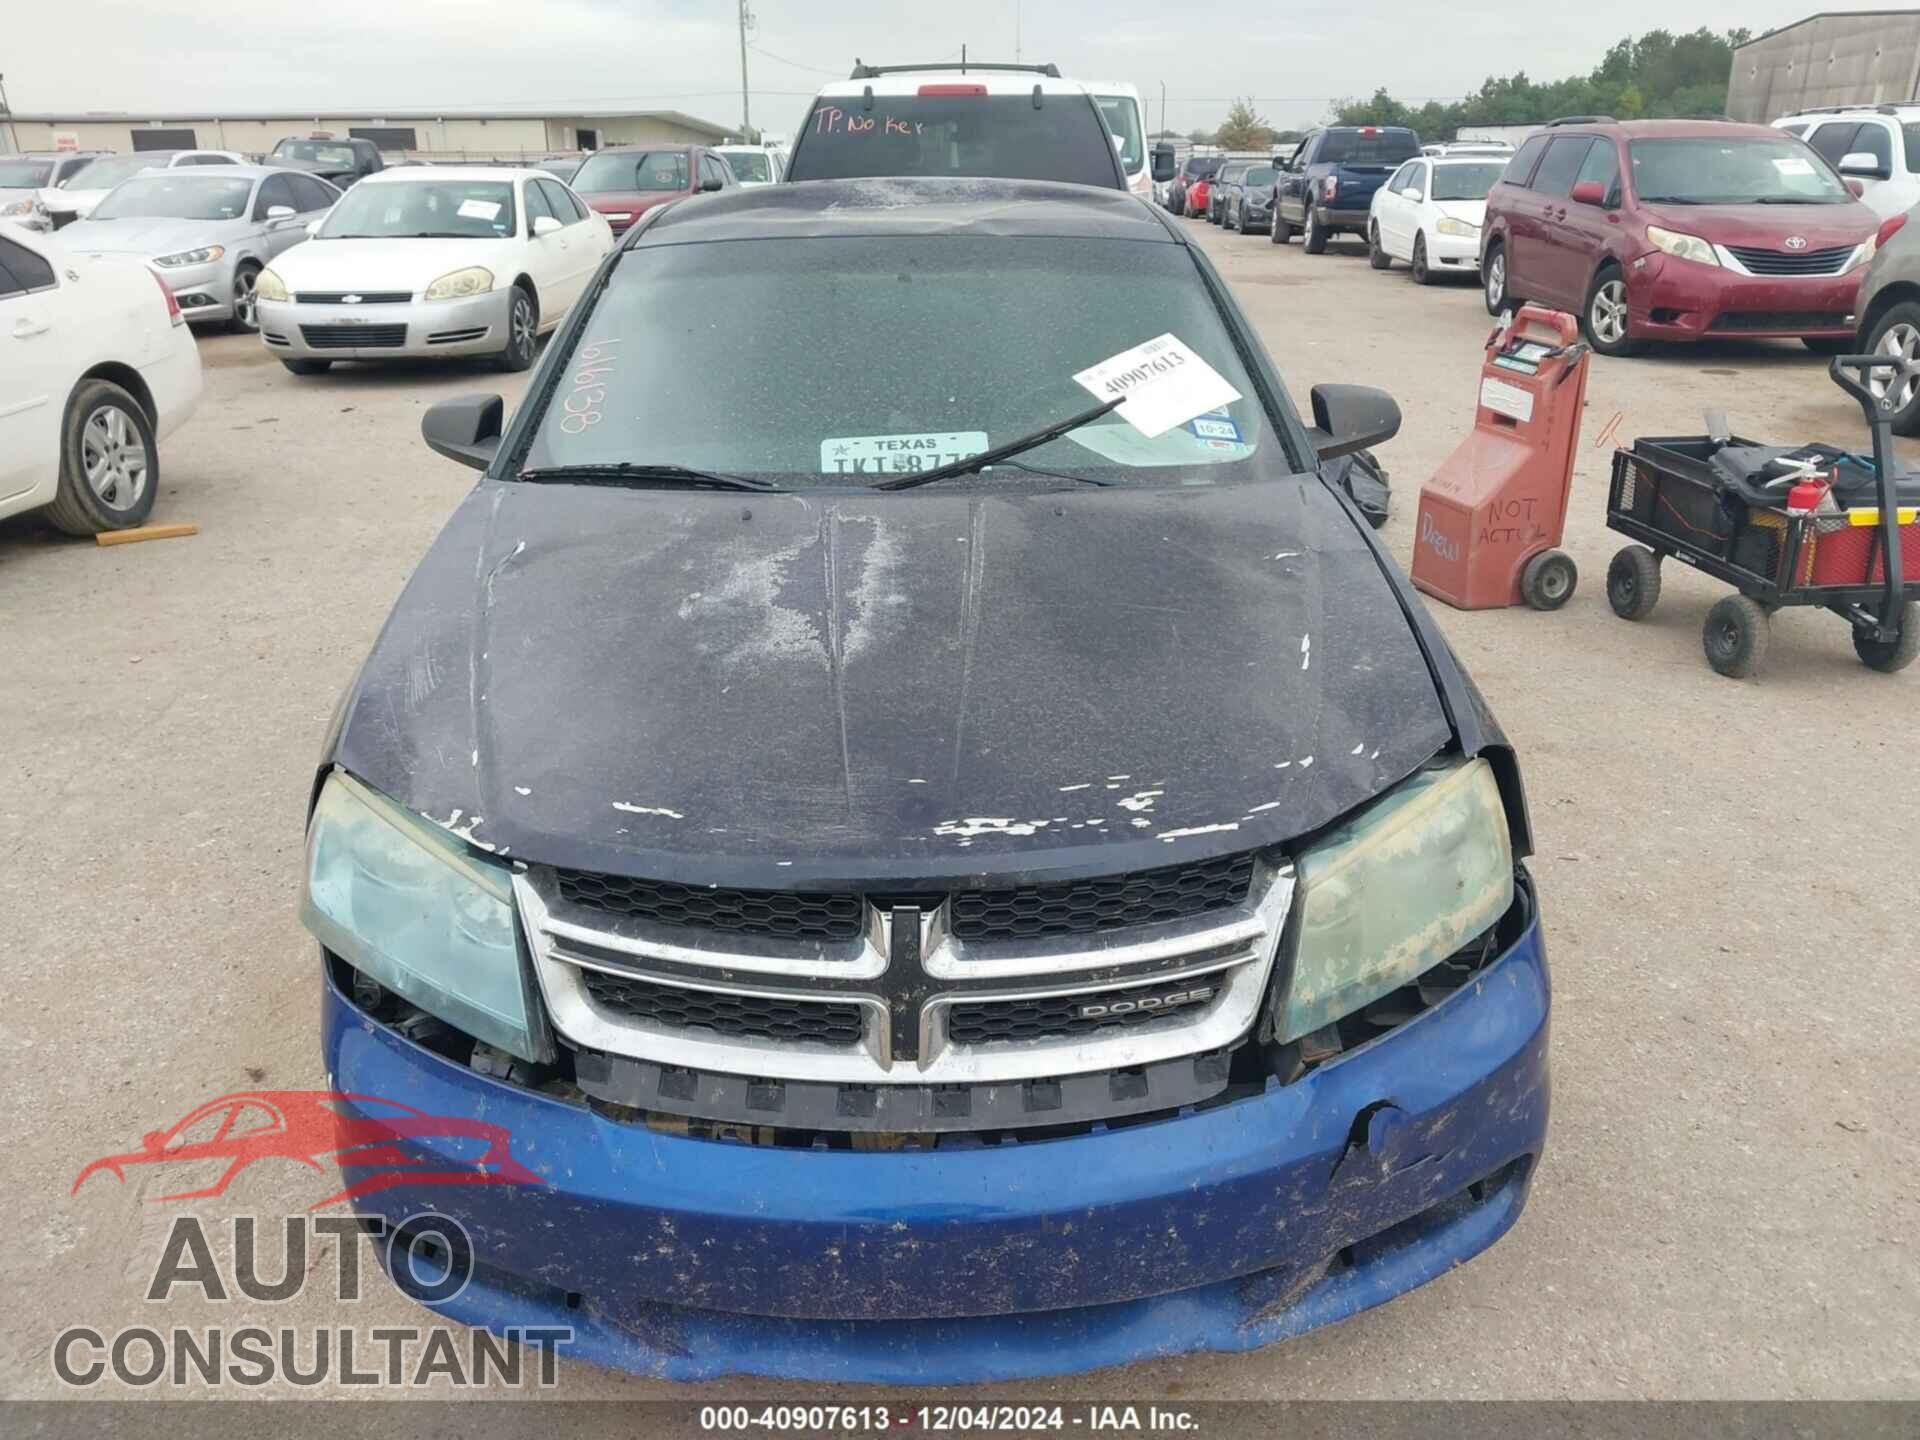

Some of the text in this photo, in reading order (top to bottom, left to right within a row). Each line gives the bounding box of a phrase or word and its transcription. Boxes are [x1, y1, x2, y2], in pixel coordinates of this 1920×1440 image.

[848, 116, 875, 132] No
[1104, 351, 1186, 393] 40907613
[874, 438, 937, 450] TEXAS
[1489, 498, 1537, 524] NOT
[1082, 987, 1214, 1016] DODGE
